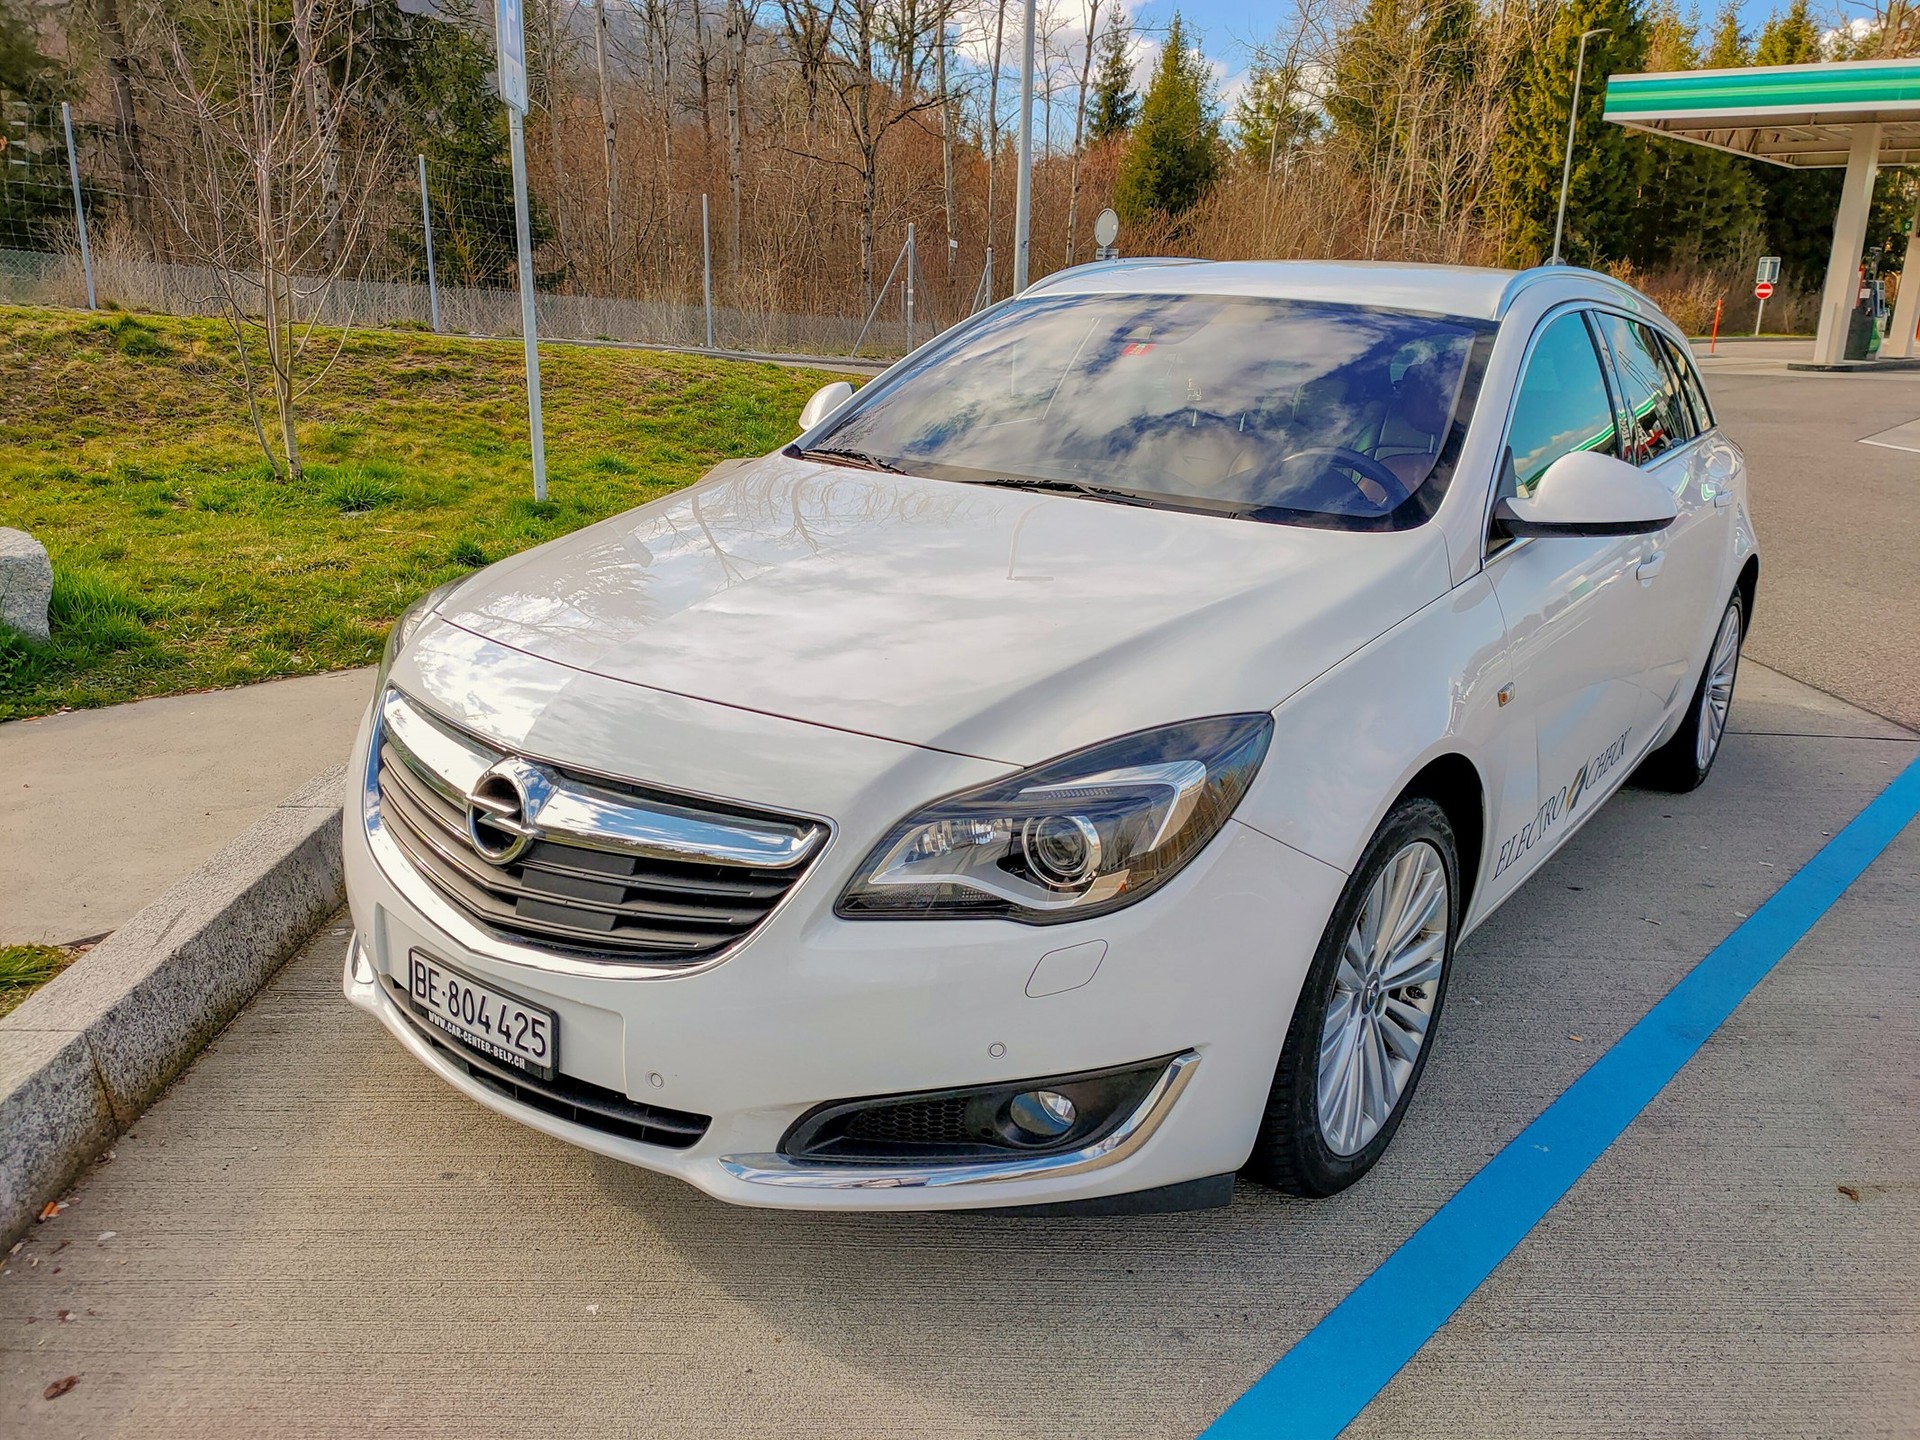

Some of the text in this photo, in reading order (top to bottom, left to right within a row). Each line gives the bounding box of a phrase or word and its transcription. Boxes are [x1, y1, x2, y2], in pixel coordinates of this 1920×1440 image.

[1492, 726, 1633, 882] ELECTRO CHECK
[428, 1010, 526, 1070] WWW.CAR-CENTER-BELP.CH
